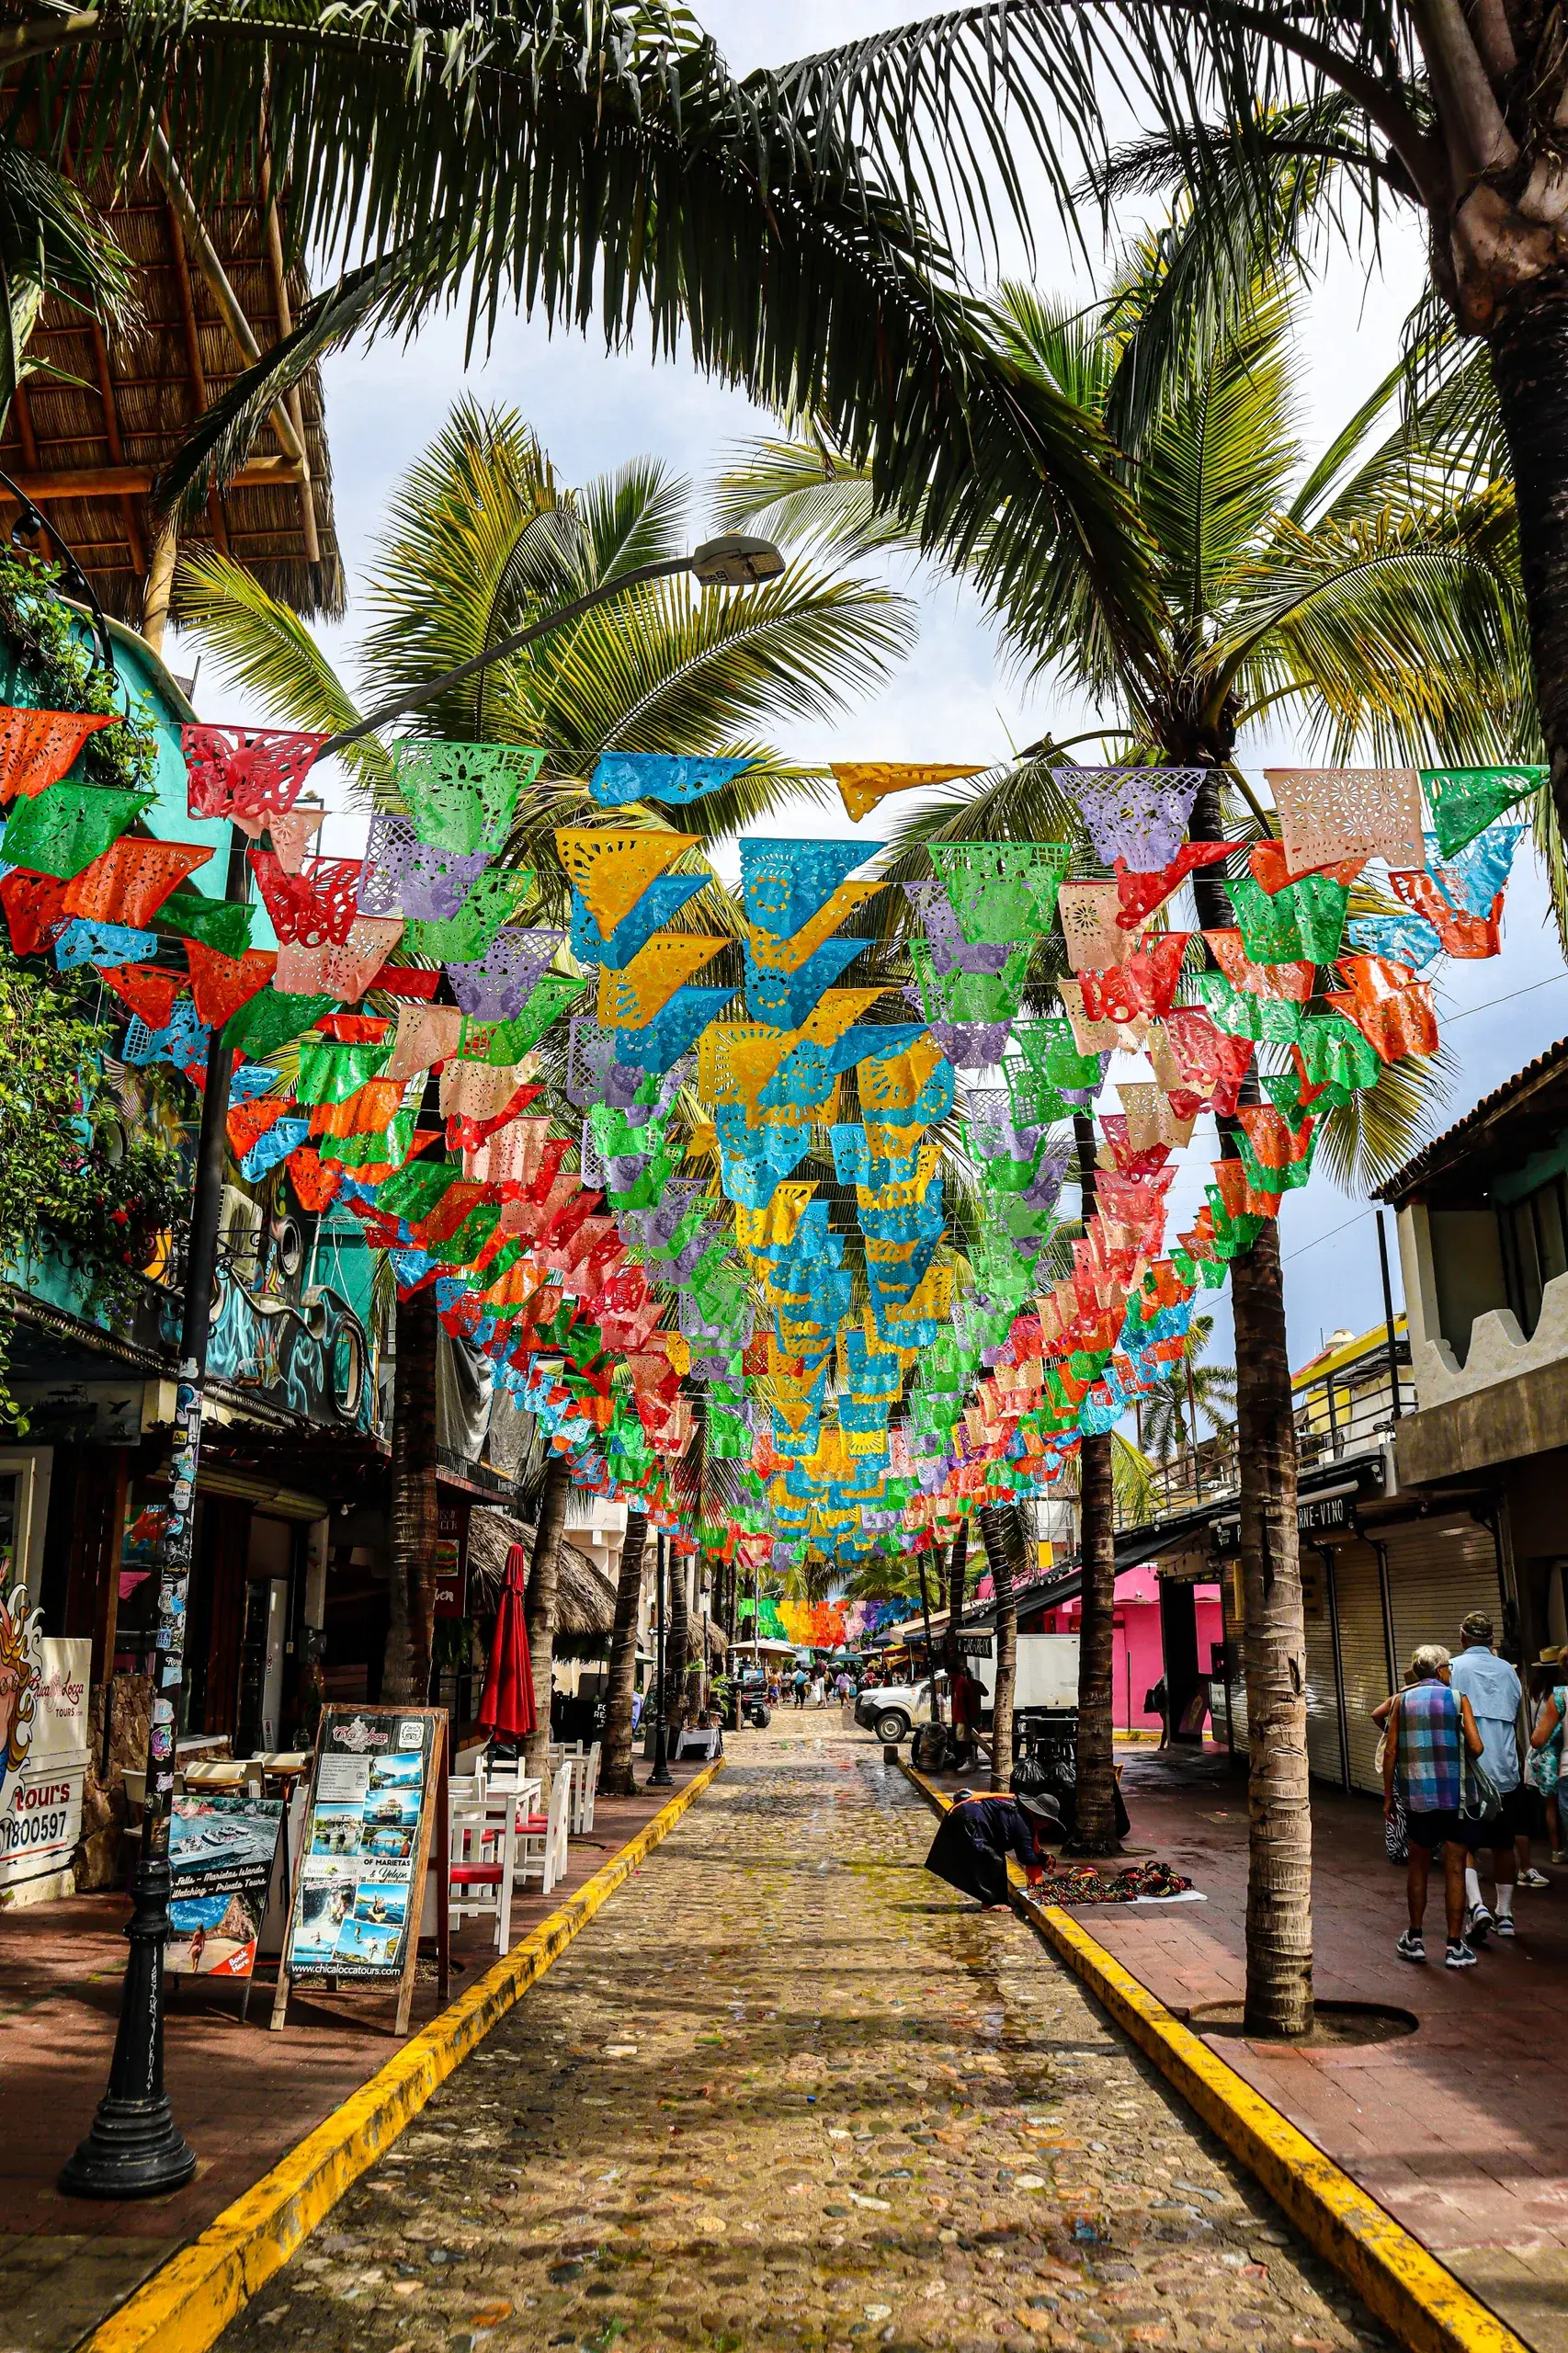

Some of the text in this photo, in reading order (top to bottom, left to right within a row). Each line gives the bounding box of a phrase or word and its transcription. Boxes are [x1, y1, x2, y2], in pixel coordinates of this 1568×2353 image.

[15, 1783, 71, 1812] tours
[175, 1876, 195, 1886] Falls
[203, 1870, 238, 1882] Marietas
[238, 1865, 266, 1876] Islands
[378, 1868, 408, 1882] Yelapa
[171, 1878, 267, 1898] Watching Private Tours
[228, 1949, 248, 1966] Book
[232, 1958, 250, 1973] Here
[291, 1963, 401, 1976] www.chicaloccatours.com
